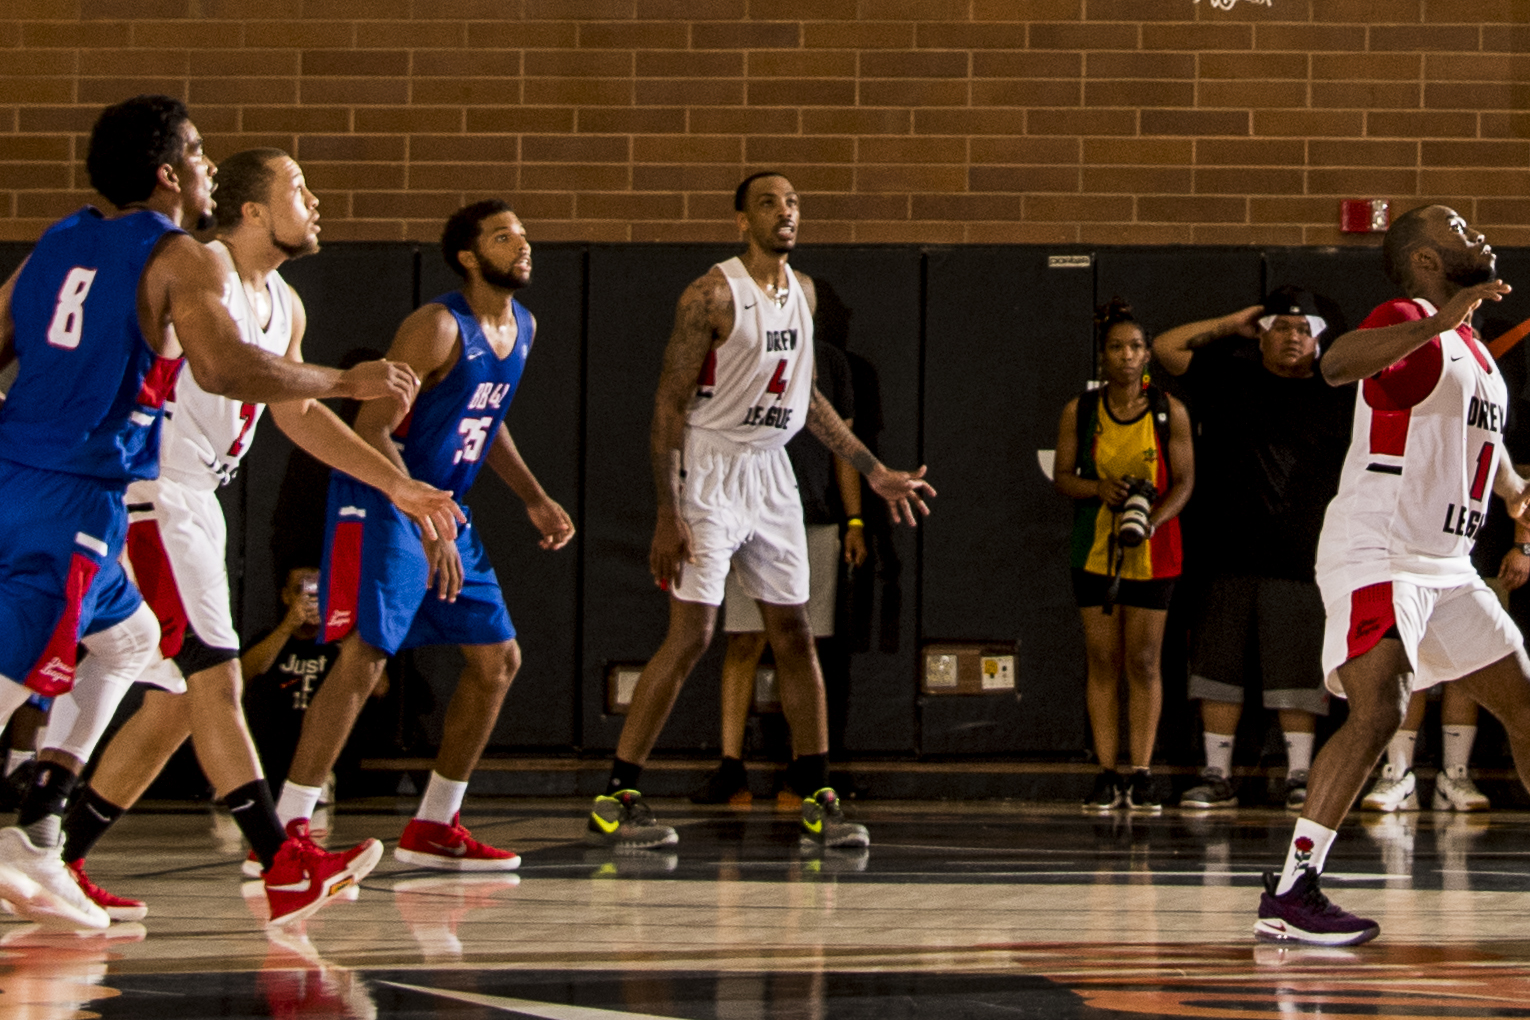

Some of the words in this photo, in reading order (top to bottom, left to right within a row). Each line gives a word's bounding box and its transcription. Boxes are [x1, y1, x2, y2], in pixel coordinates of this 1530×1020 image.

[45, 265, 98, 351] 8
[766, 329, 798, 353] DREW
[766, 358, 788, 400] 4
[743, 405, 793, 430] LEGUE
[453, 416, 493, 465] 35
[1470, 441, 1495, 503] 1
[280, 653, 327, 676] Just
